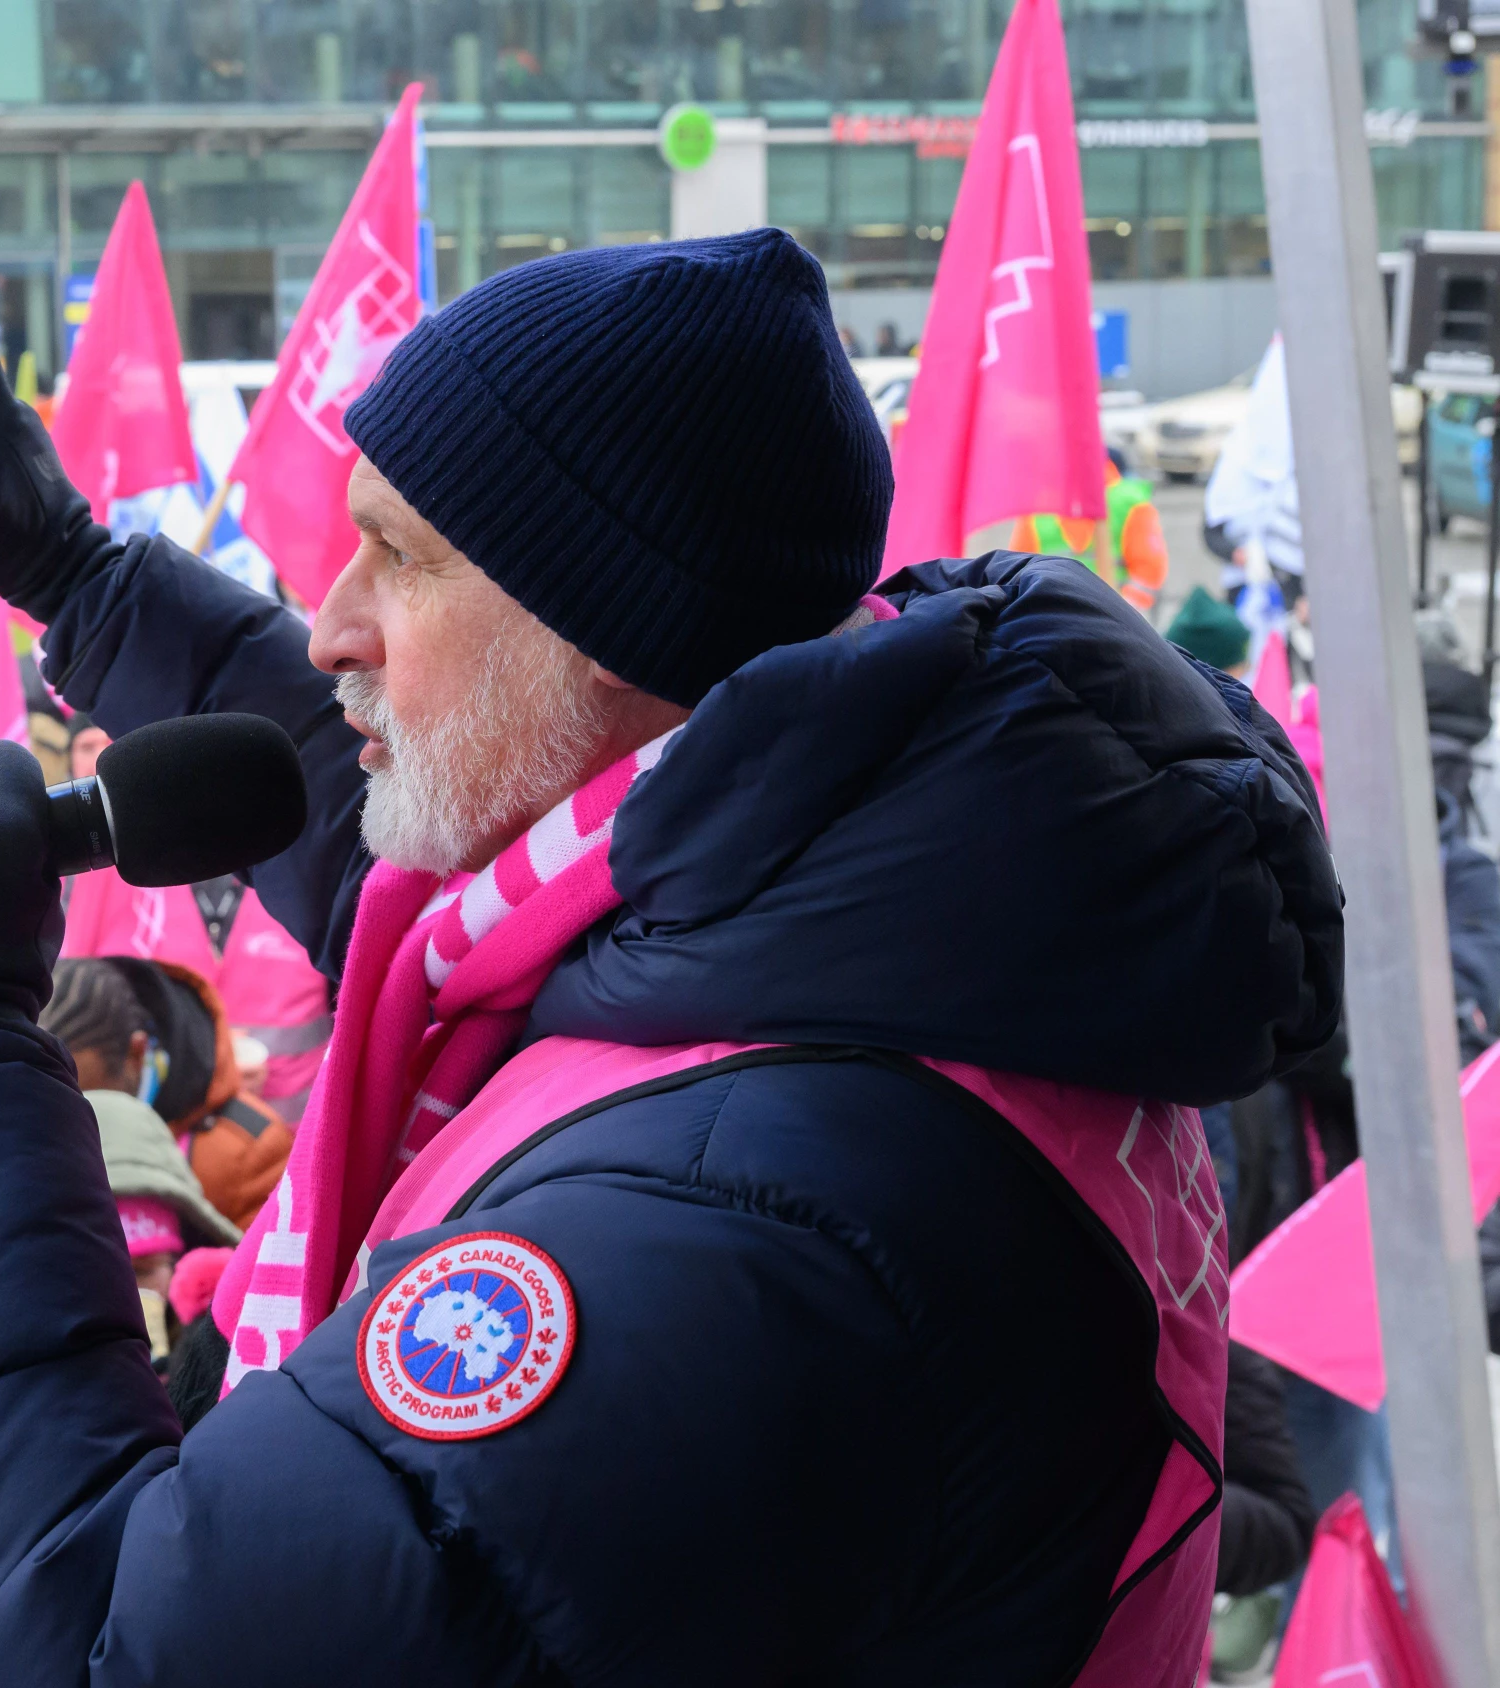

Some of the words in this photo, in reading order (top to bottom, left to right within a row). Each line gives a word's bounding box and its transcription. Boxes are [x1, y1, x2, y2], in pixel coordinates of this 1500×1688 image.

[459, 1249, 525, 1274] CANADA
[522, 1269, 554, 1319] GOOSE
[376, 1340, 403, 1396] ARCTIC
[399, 1393, 479, 1420] PROGRAM
